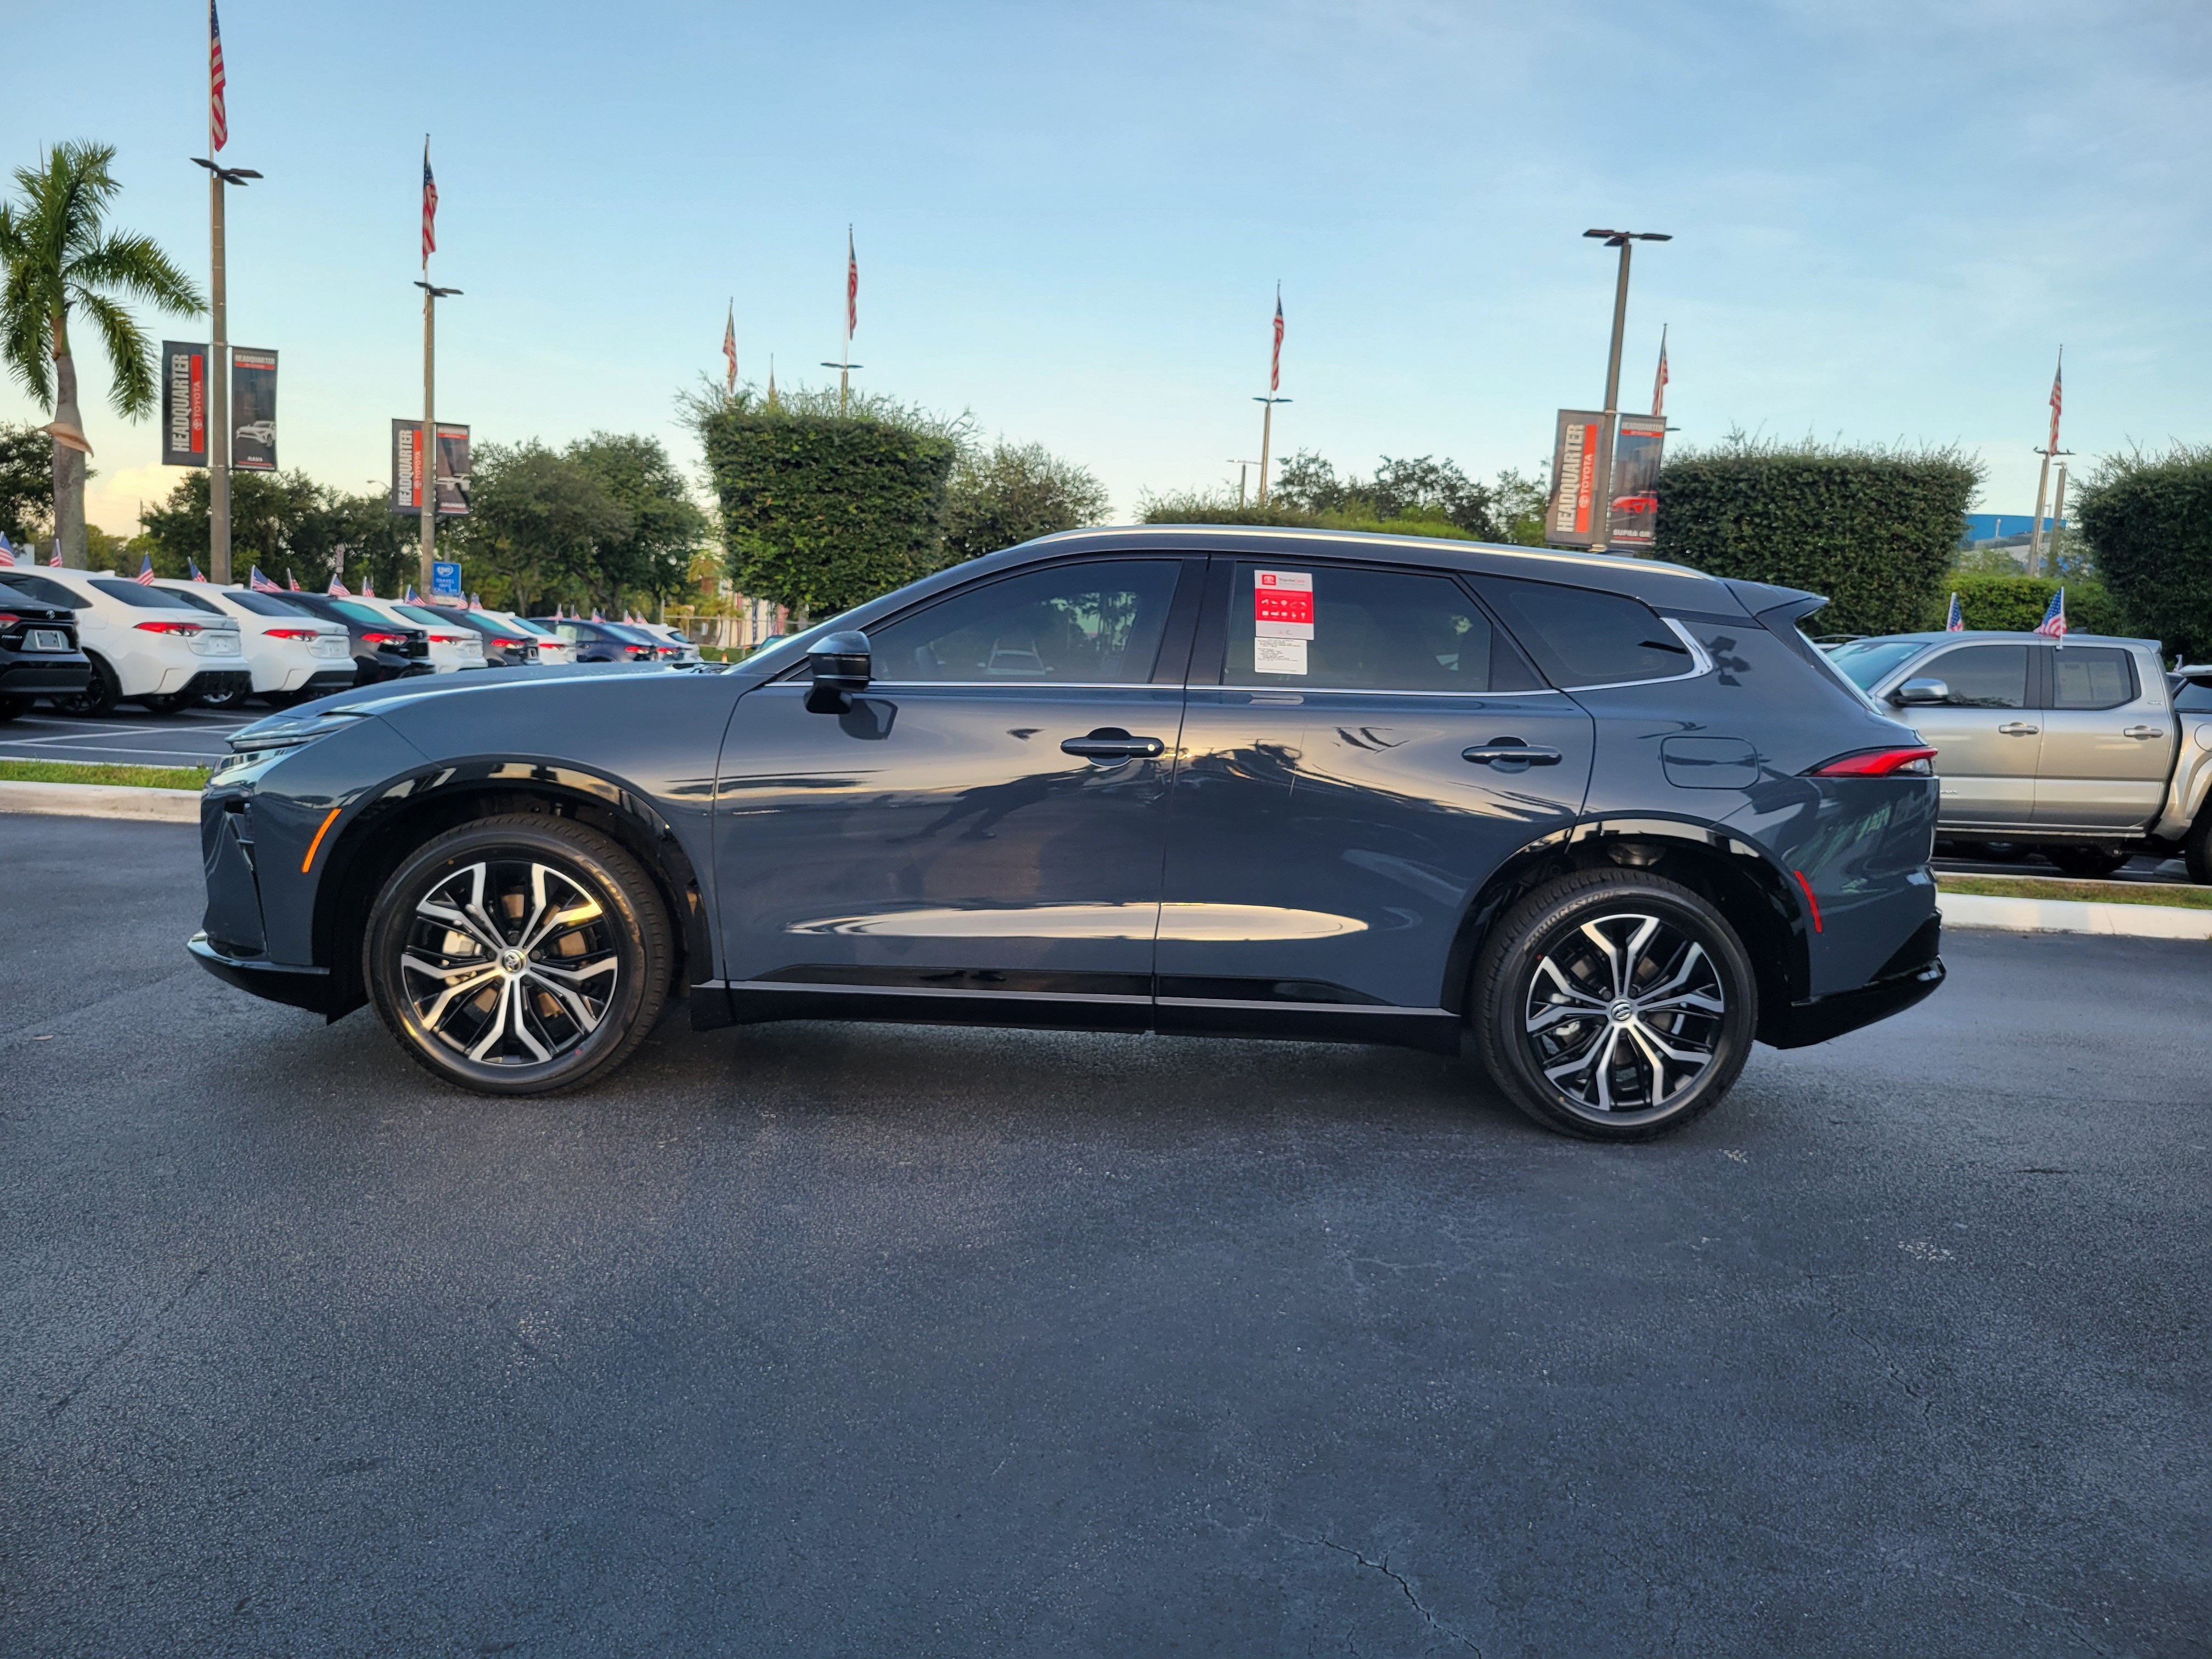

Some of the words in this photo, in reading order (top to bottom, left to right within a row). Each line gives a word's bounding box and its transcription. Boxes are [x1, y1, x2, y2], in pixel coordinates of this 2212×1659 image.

[172, 354, 192, 453] HEADQUARTER
[398, 430, 414, 506] HEADQUARTER
[1556, 424, 1585, 532] HEADQUARTER
[1581, 453, 1594, 494] TOYOTA
